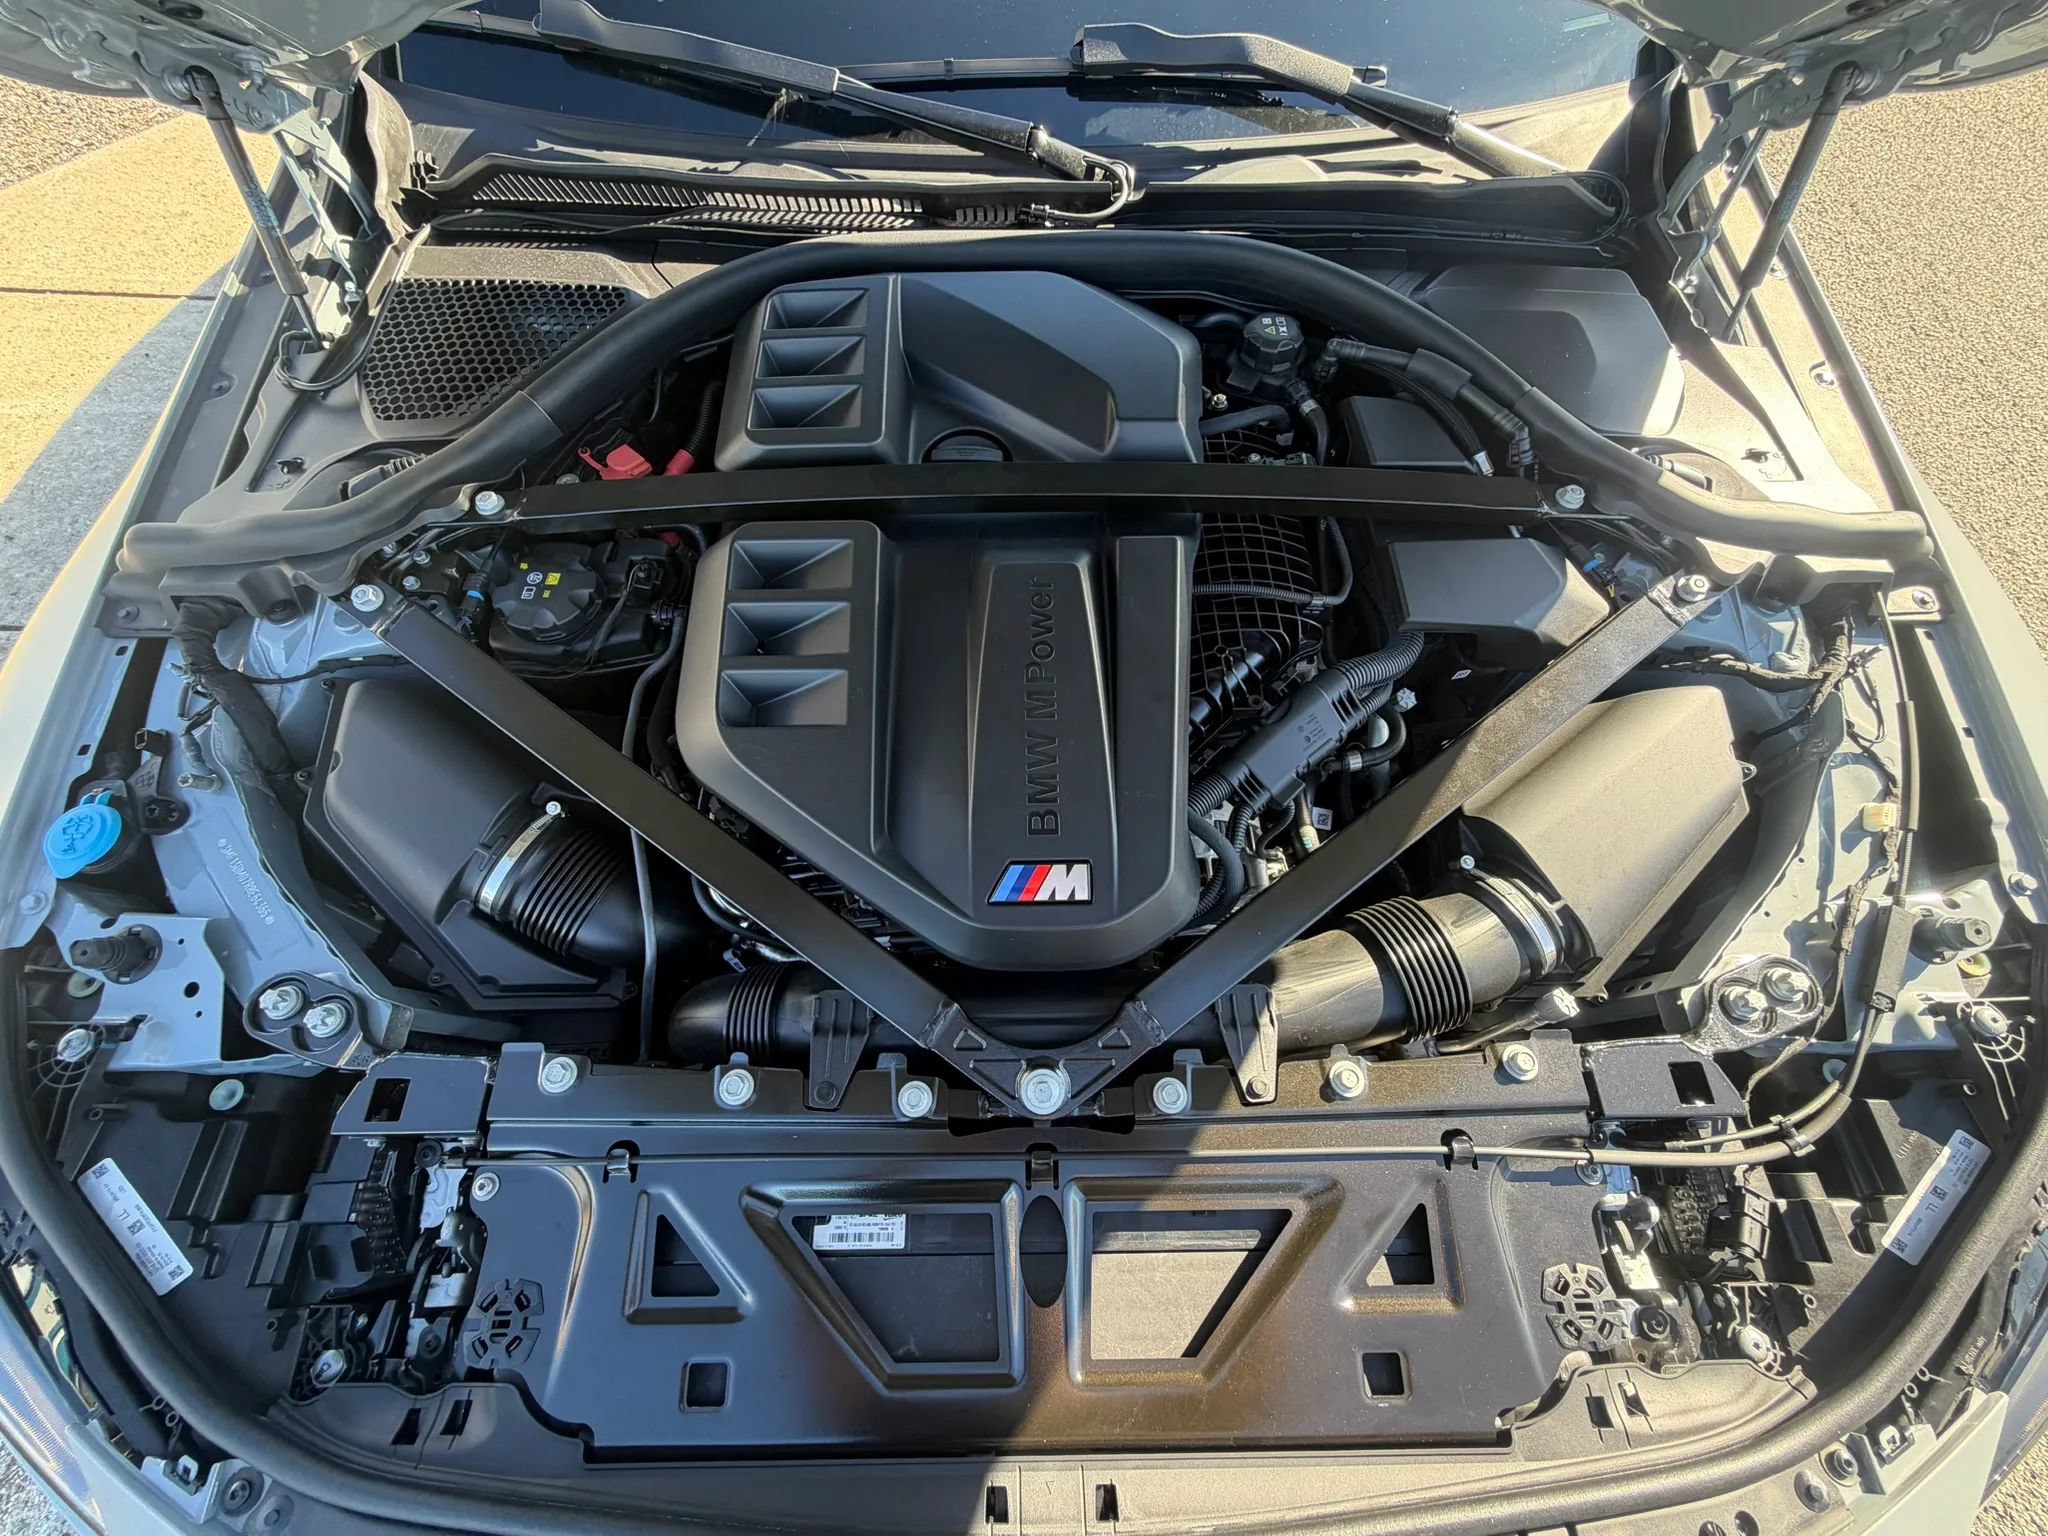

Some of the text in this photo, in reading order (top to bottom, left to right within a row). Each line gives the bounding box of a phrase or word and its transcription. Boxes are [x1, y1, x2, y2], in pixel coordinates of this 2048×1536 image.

[1023, 576, 1061, 837] BMW MPower
[1034, 863, 1091, 902] M
